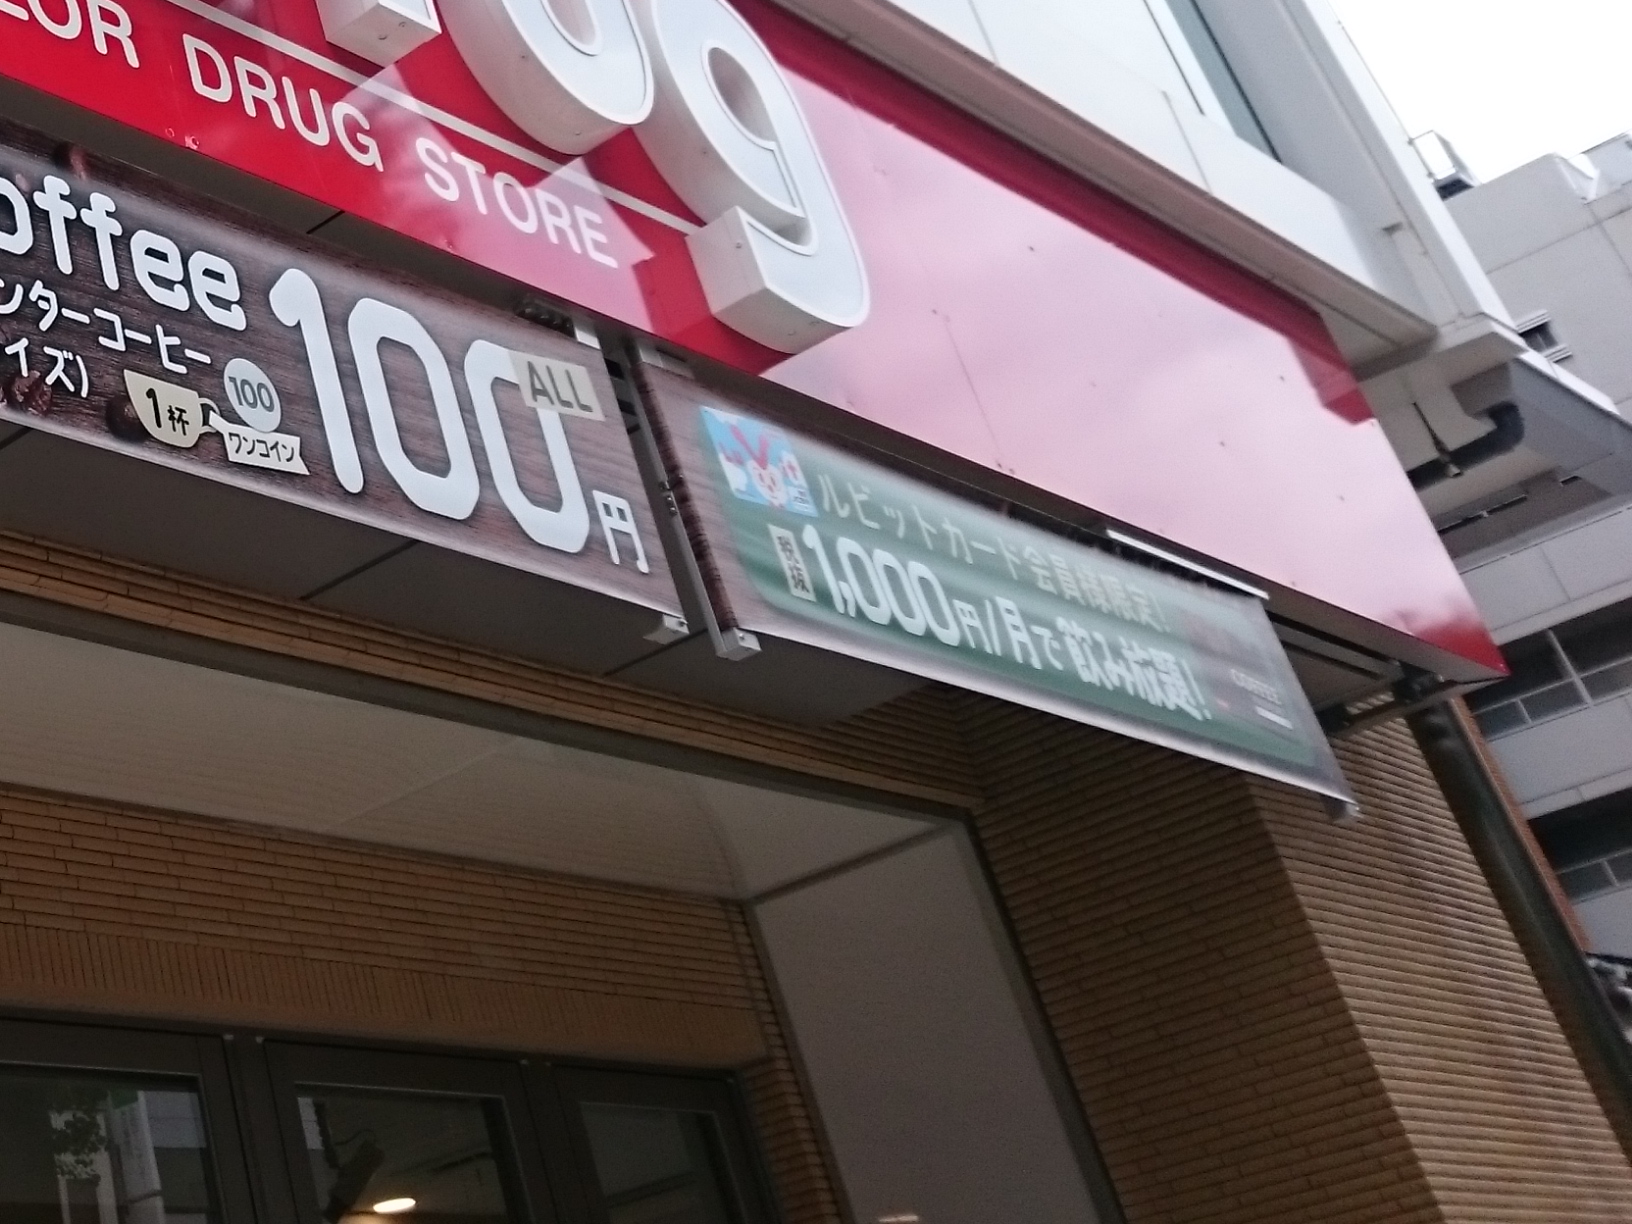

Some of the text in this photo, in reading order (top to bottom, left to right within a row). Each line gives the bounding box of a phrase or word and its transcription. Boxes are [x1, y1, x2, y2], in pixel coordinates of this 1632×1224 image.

[183, 35, 384, 172] DRUG
[415, 136, 619, 268] STORE
[228, 376, 276, 414] 100
[526, 360, 594, 413] ALL
[228, 432, 295, 463] ワンコイン
